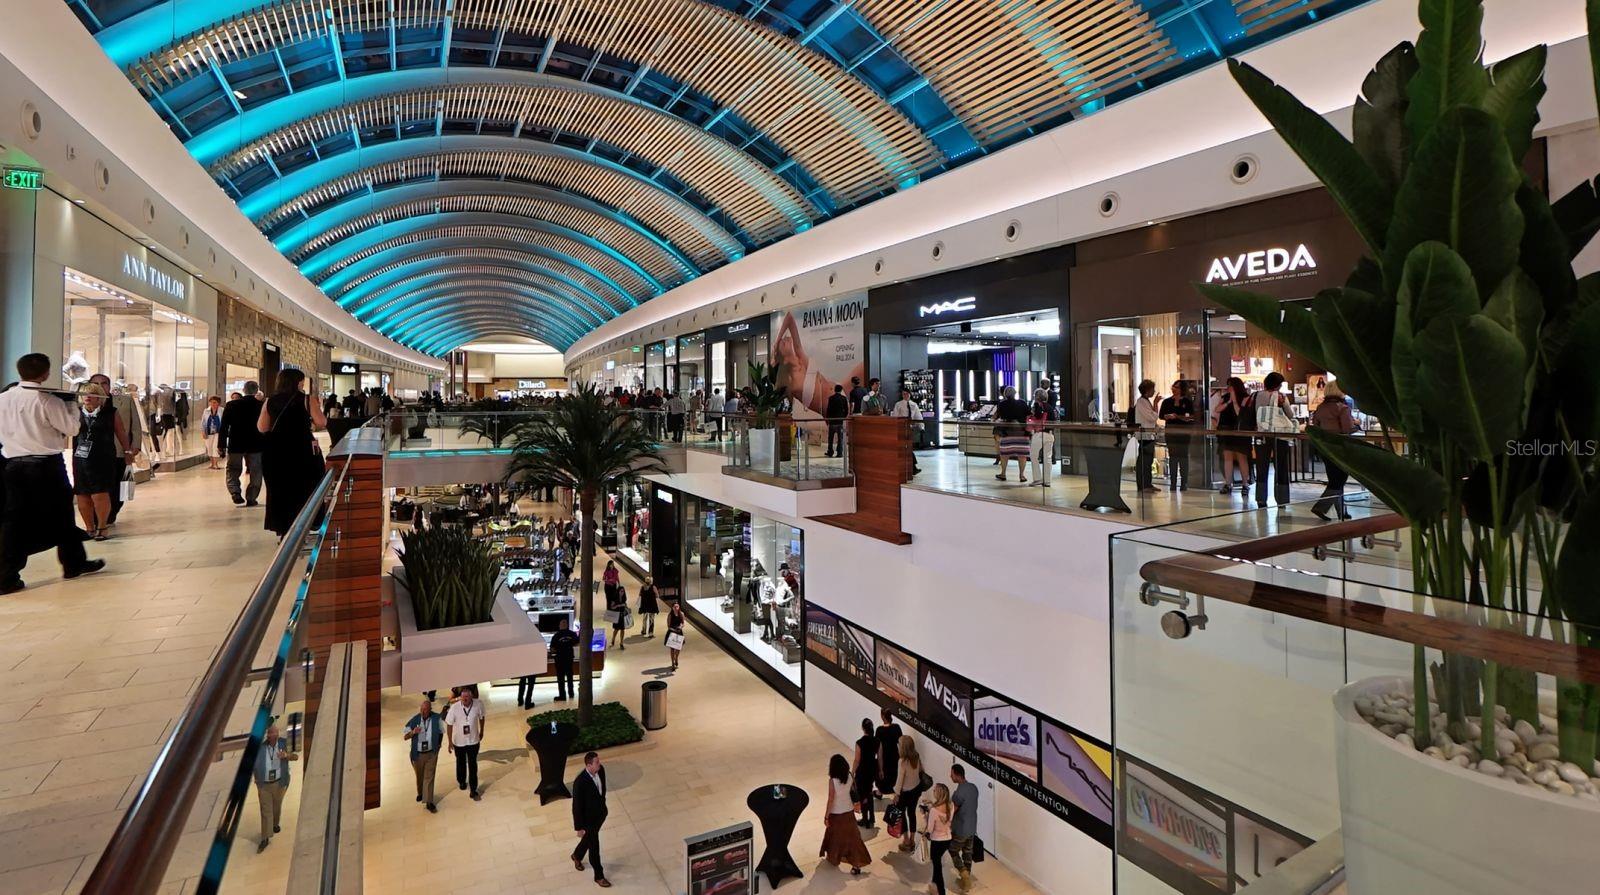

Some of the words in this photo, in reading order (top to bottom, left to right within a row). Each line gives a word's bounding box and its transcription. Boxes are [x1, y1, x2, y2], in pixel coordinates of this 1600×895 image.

[11, 172, 38, 188] EXIT
[123, 254, 147, 281] ANN
[149, 266, 185, 300] TAYLOR
[1205, 243, 1317, 283] AVEDA
[802, 307, 833, 328] BANANA
[834, 301, 864, 323] MOON
[920, 297, 976, 317] MAC
[518, 380, 546, 389] Dillard's
[807, 622, 828, 637] FOREVER
[828, 625, 835, 640] 21
[924, 670, 968, 728] AVEDA
[978, 716, 1031, 745] claire's
[913, 718, 927, 730] DINE
[928, 728, 940, 739] AND
[941, 734, 966, 755] EXPLORE
[968, 751, 980, 764] THE
[982, 760, 1010, 782] CENTER
[1011, 776, 1022, 786] OF
[1024, 784, 1069, 816] ATTENTION
